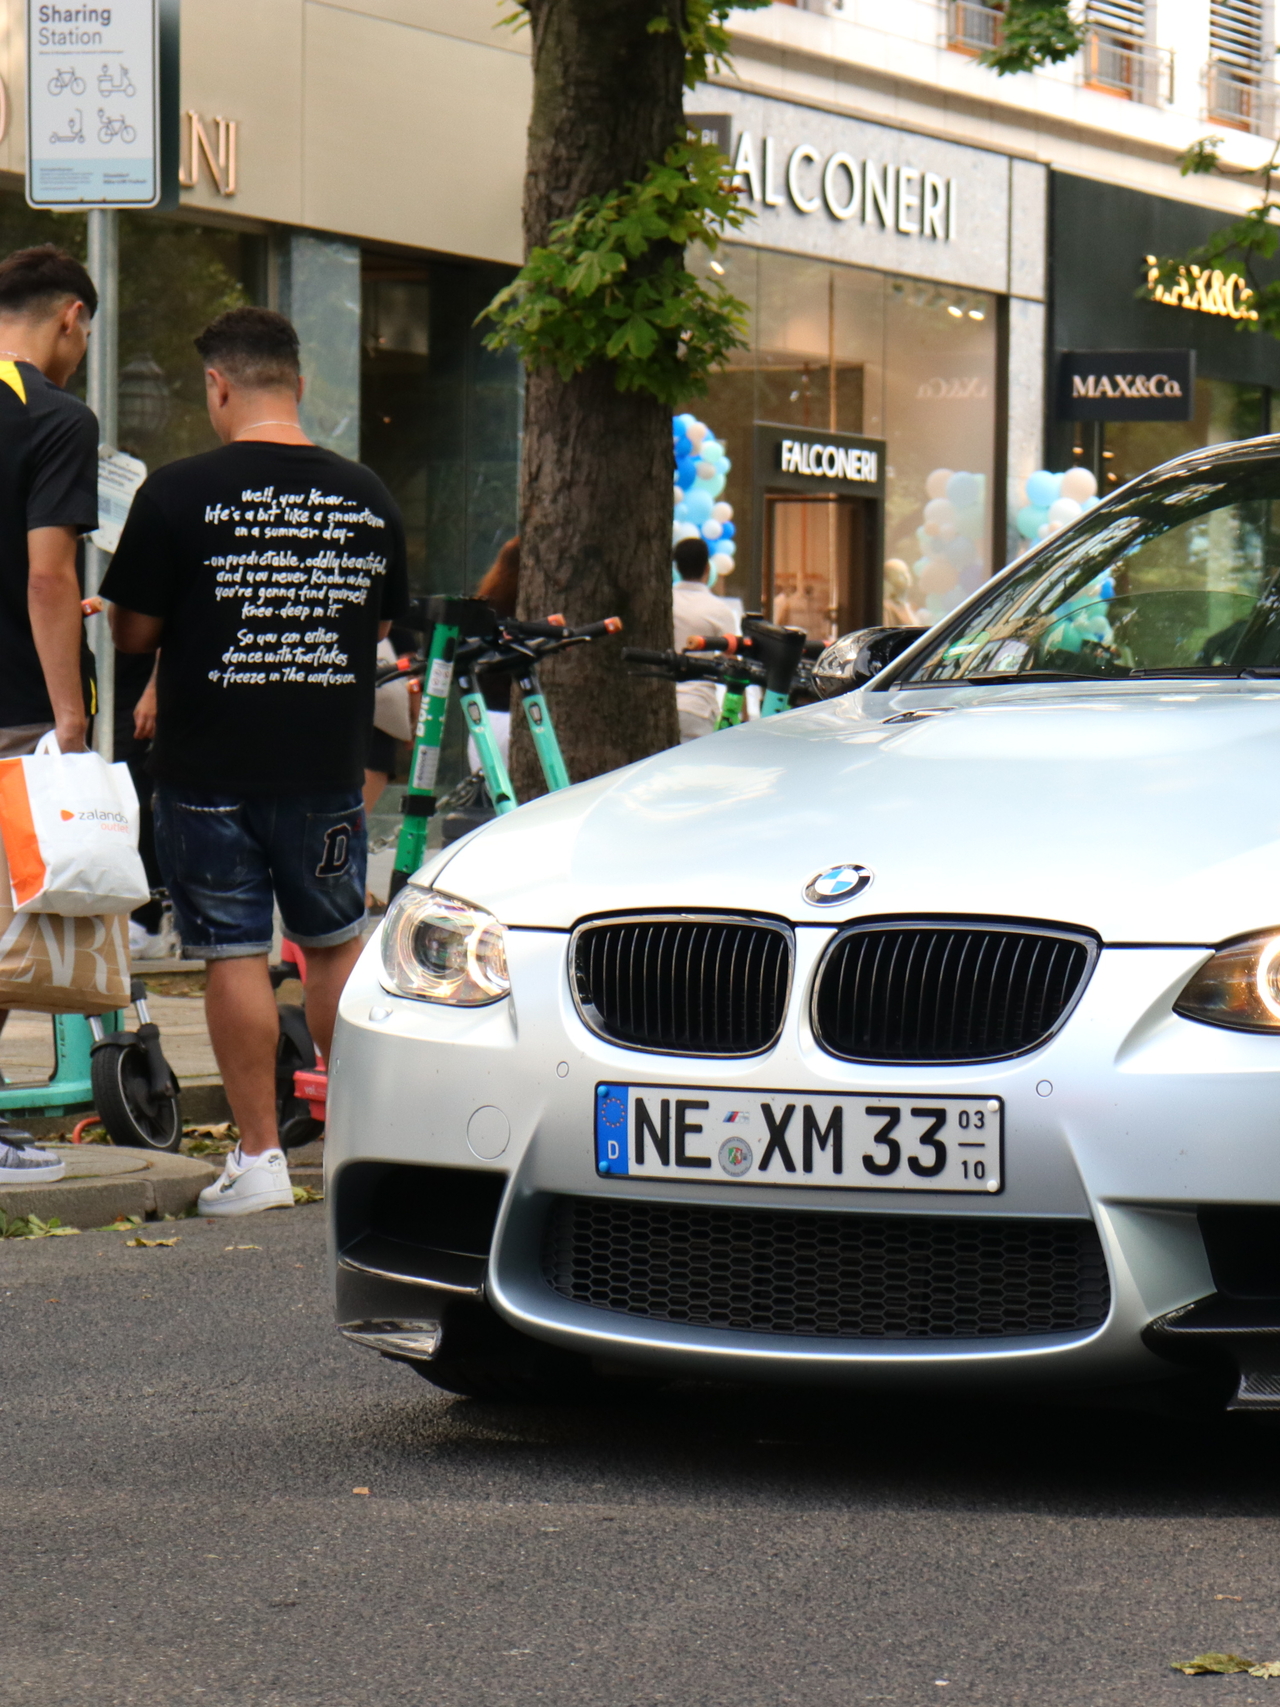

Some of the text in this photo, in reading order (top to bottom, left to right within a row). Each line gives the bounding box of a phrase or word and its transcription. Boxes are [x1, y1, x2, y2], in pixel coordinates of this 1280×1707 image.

[38, 4, 111, 26] Sharing
[38, 27, 102, 46] Station
[722, 130, 957, 240] ALCONERI
[1072, 374, 1183, 398] MAX&Co.
[781, 439, 878, 483] FALCONERI
[279, 494, 305, 508] you
[204, 504, 385, 528] life's a bit like a snowstorm
[234, 526, 248, 537] on
[251, 526, 260, 537] a
[264, 526, 319, 539] summer
[305, 550, 341, 576] oddly
[216, 566, 244, 583] and
[246, 570, 269, 584] you
[271, 571, 308, 584] never
[215, 585, 368, 606] you're gonna find yourself
[313, 606, 324, 617] in
[237, 627, 339, 646] So you can either
[222, 644, 348, 667] dance with the flakes
[208, 669, 221, 682] or
[222, 666, 266, 688] freeze
[269, 672, 281, 681] in
[78, 808, 129, 824] zalando
[101, 822, 129, 834] outlet
[315, 822, 352, 878] D
[958, 1110, 986, 1129] 03
[607, 1140, 619, 1160] D
[634, 1097, 712, 1169] NE
[758, 1102, 843, 1175] XM
[862, 1106, 948, 1178] 33
[961, 1160, 986, 1180] 10
